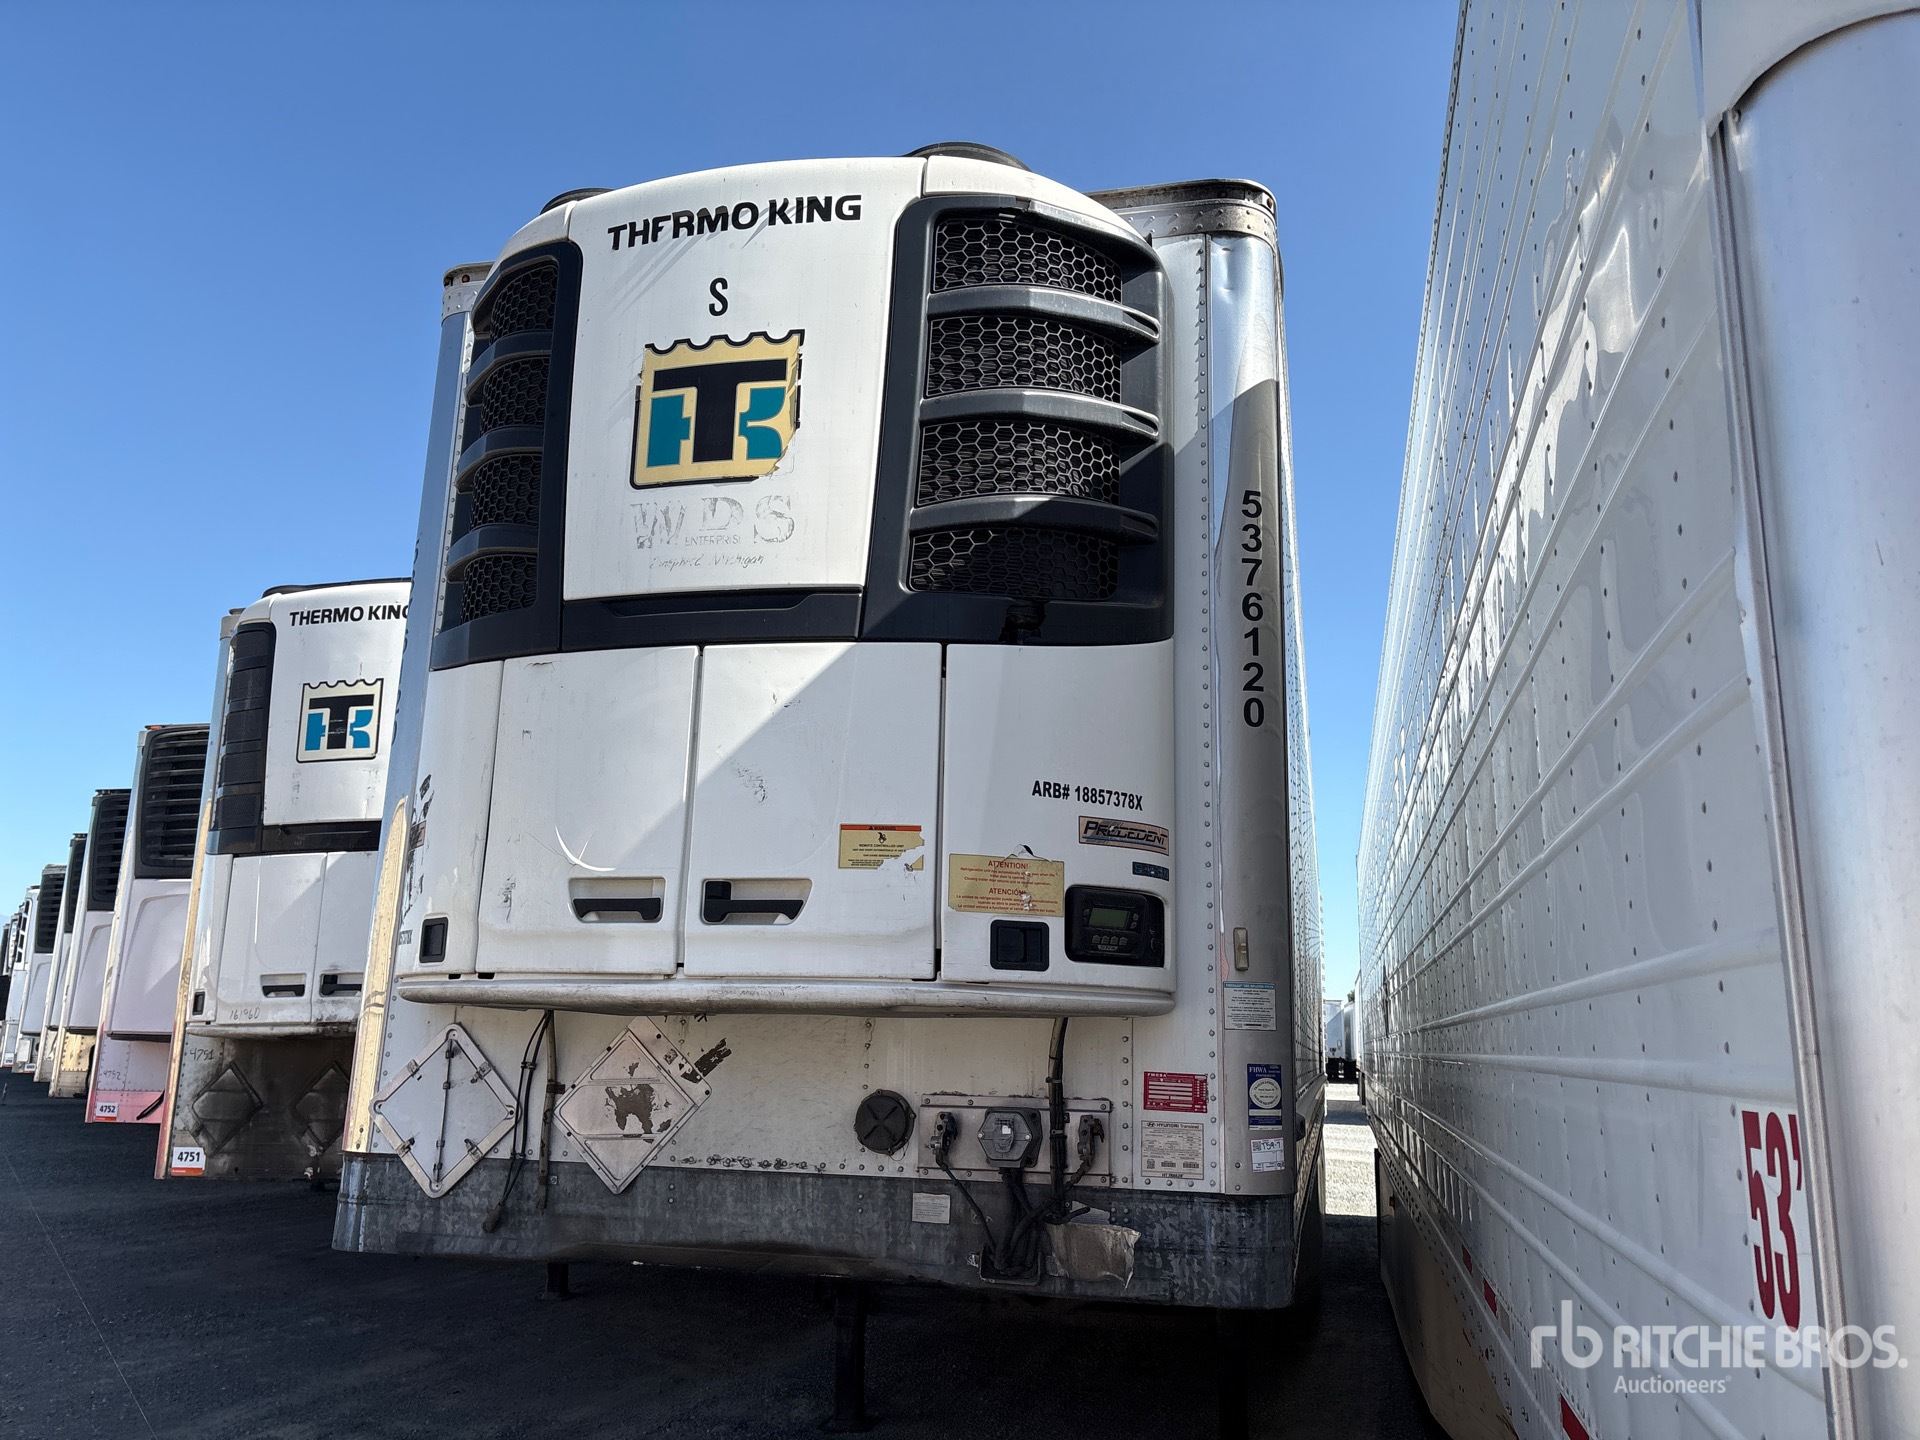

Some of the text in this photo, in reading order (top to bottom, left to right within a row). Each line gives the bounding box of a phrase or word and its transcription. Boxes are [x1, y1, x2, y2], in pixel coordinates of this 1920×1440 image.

[768, 194, 862, 227] KING
[708, 277, 729, 317] S
[289, 605, 364, 626] THERMO
[1241, 489, 1265, 728] 5376120
[1031, 779, 1144, 811] ARB# 18857378X
[988, 860, 1028, 869] ATTENTION!
[100, 1105, 116, 1113] 4752
[177, 1151, 201, 1162] 4751
